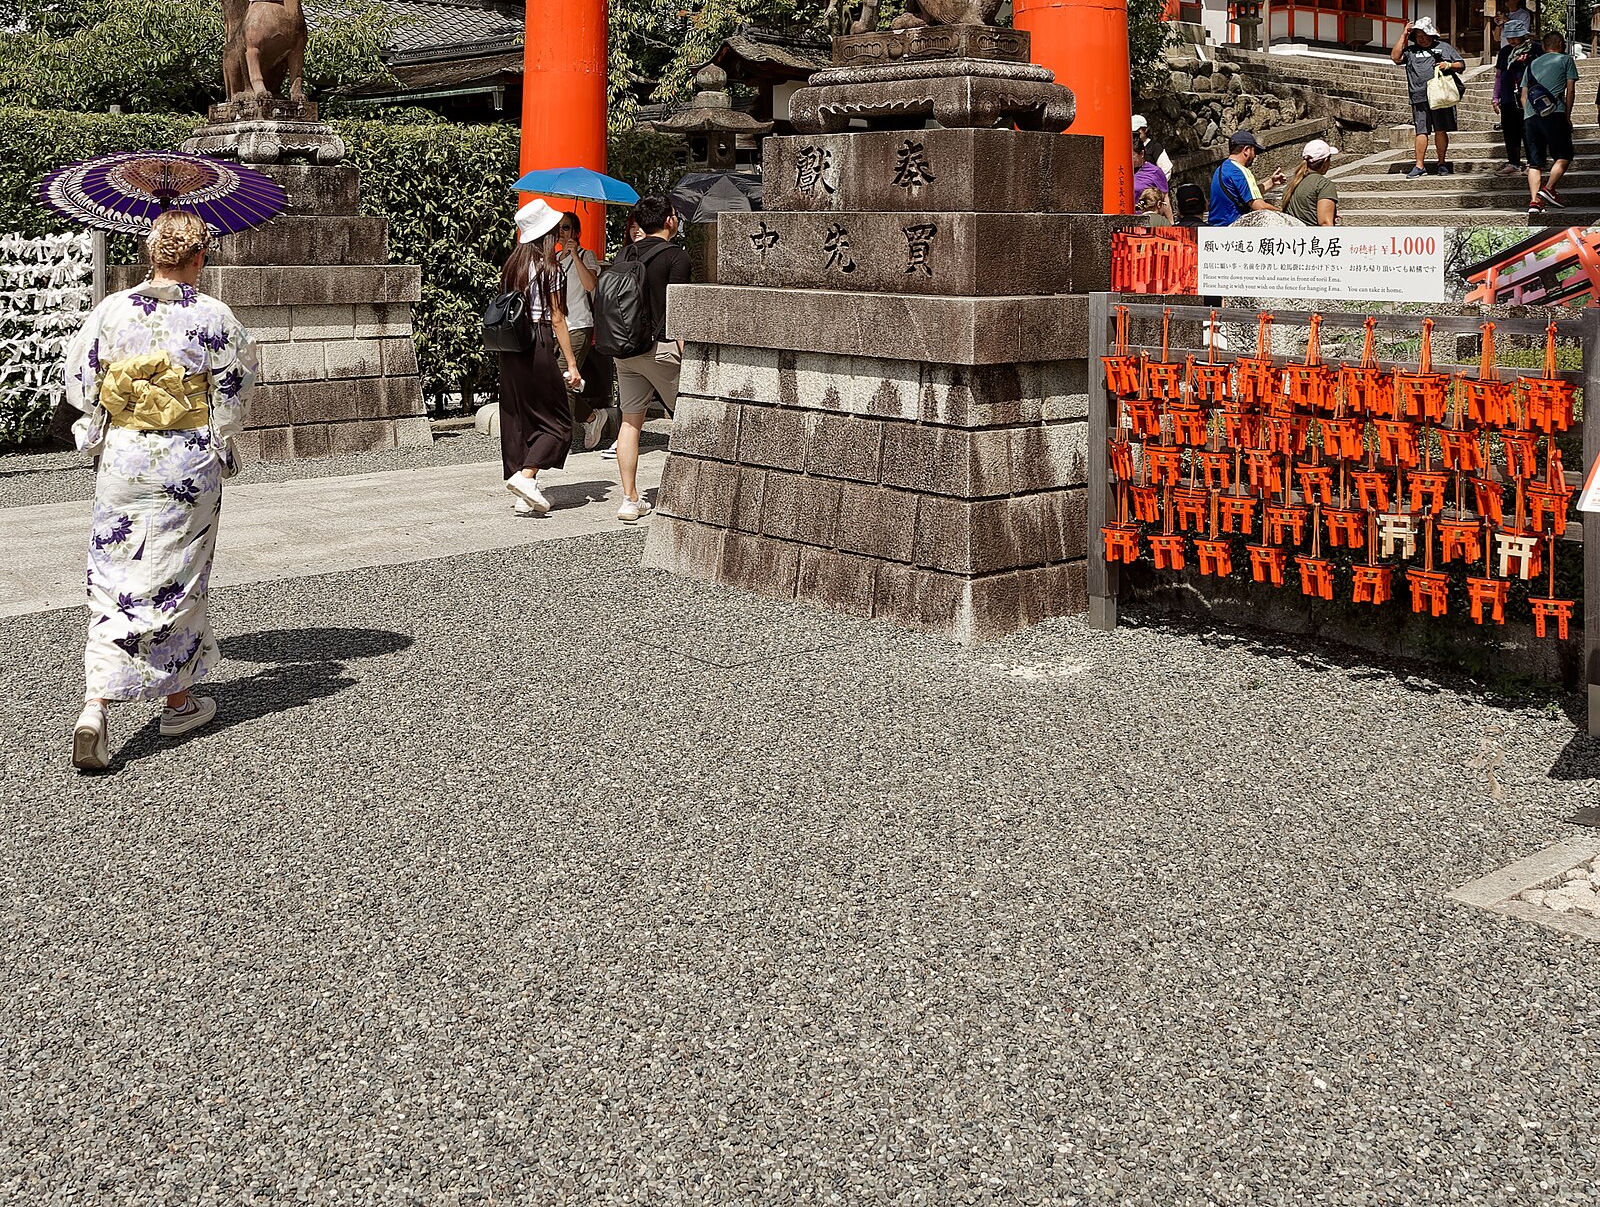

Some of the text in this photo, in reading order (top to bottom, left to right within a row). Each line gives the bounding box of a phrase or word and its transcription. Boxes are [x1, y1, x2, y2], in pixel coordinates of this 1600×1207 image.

[1203, 240, 1254, 253] 願いが通る
[1258, 236, 1342, 257] 願かけ鳥居
[1217, 283, 1229, 291] hang
[1307, 285, 1328, 293] hanging
